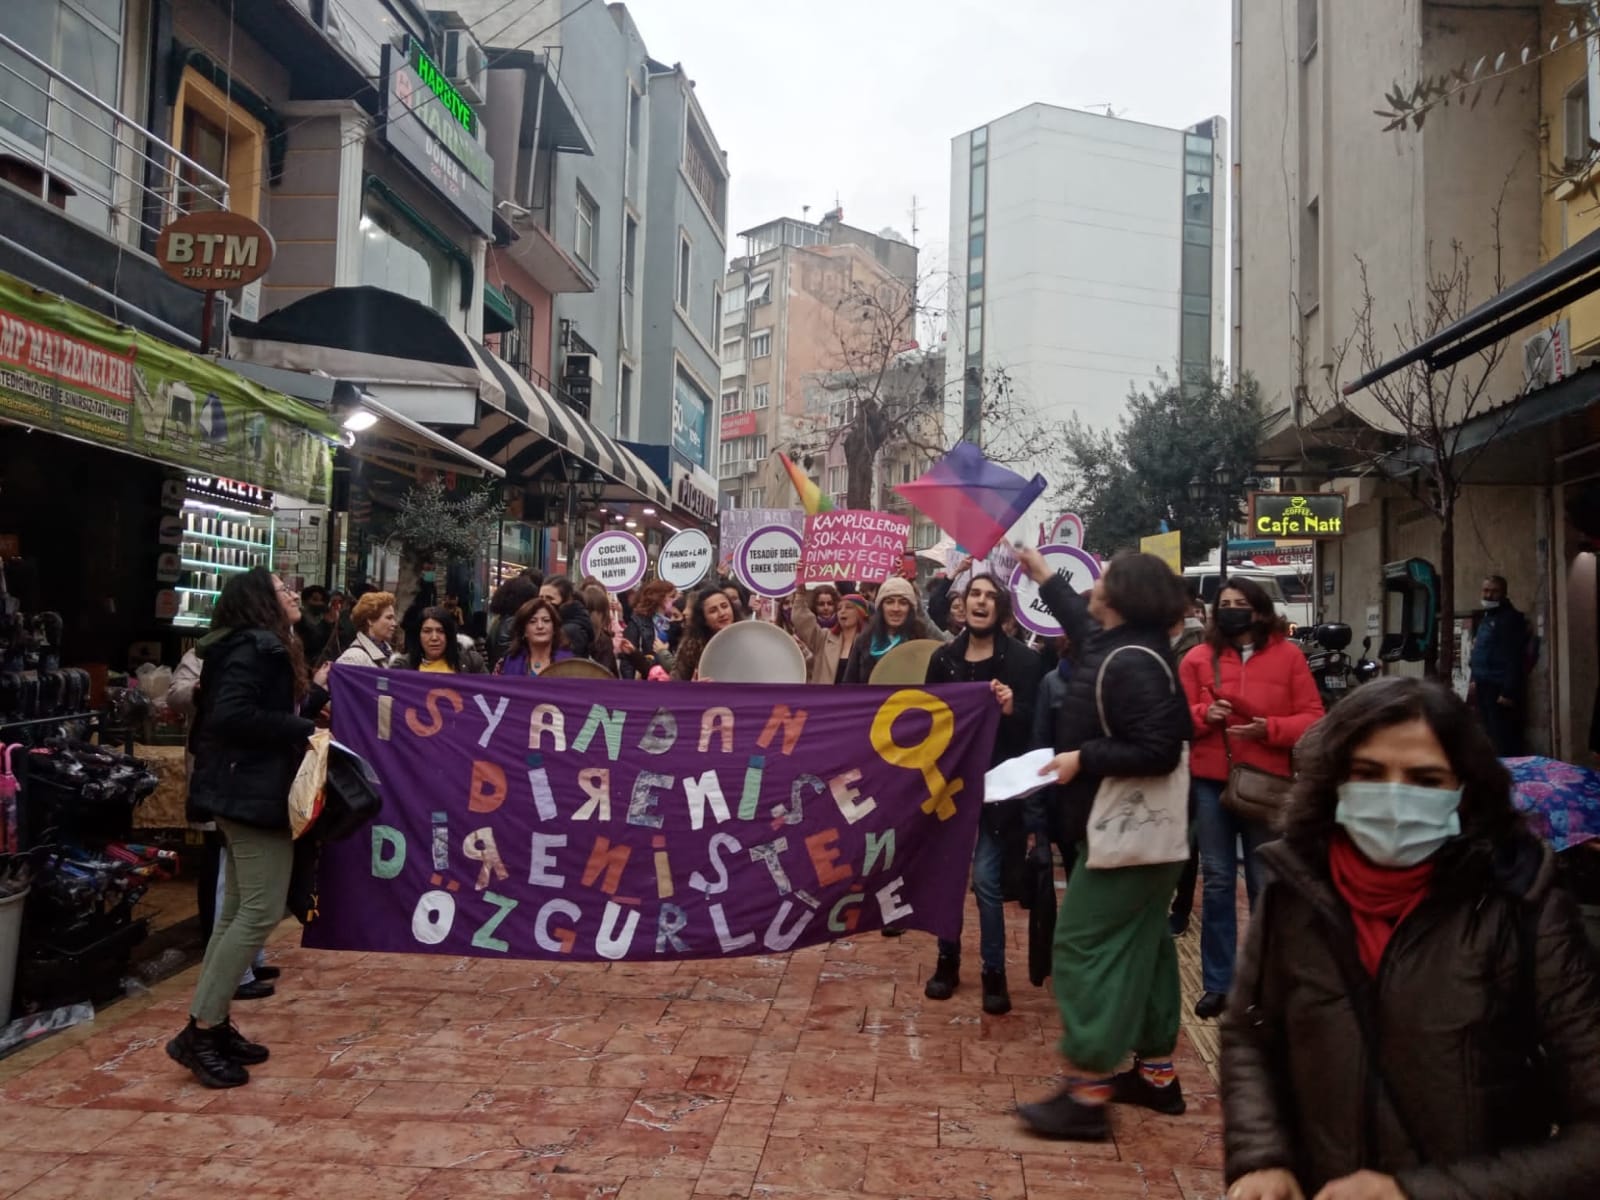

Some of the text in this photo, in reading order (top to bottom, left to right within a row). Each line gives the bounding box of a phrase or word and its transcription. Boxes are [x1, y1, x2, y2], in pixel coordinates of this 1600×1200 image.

[167, 232, 259, 267] BTM
[214, 268, 241, 280] BTM
[1284, 507, 1311, 516] COFFEE
[1257, 515, 1341, 536] Cafe Natt
[811, 531, 905, 553] SOKAKLARA
[598, 544, 627, 556] ÇOCUK
[665, 547, 708, 558] TRANS+LAR
[749, 547, 779, 560] TESADÜF
[590, 554, 637, 568] İSTİSMARINA
[602, 568, 626, 579] HAYIR
[751, 563, 772, 574] ERKEK
[376, 676, 809, 761] İSYANDAN
[468, 753, 877, 831] DİRENİŞE
[371, 811, 896, 900] DİRENİŞTEN
